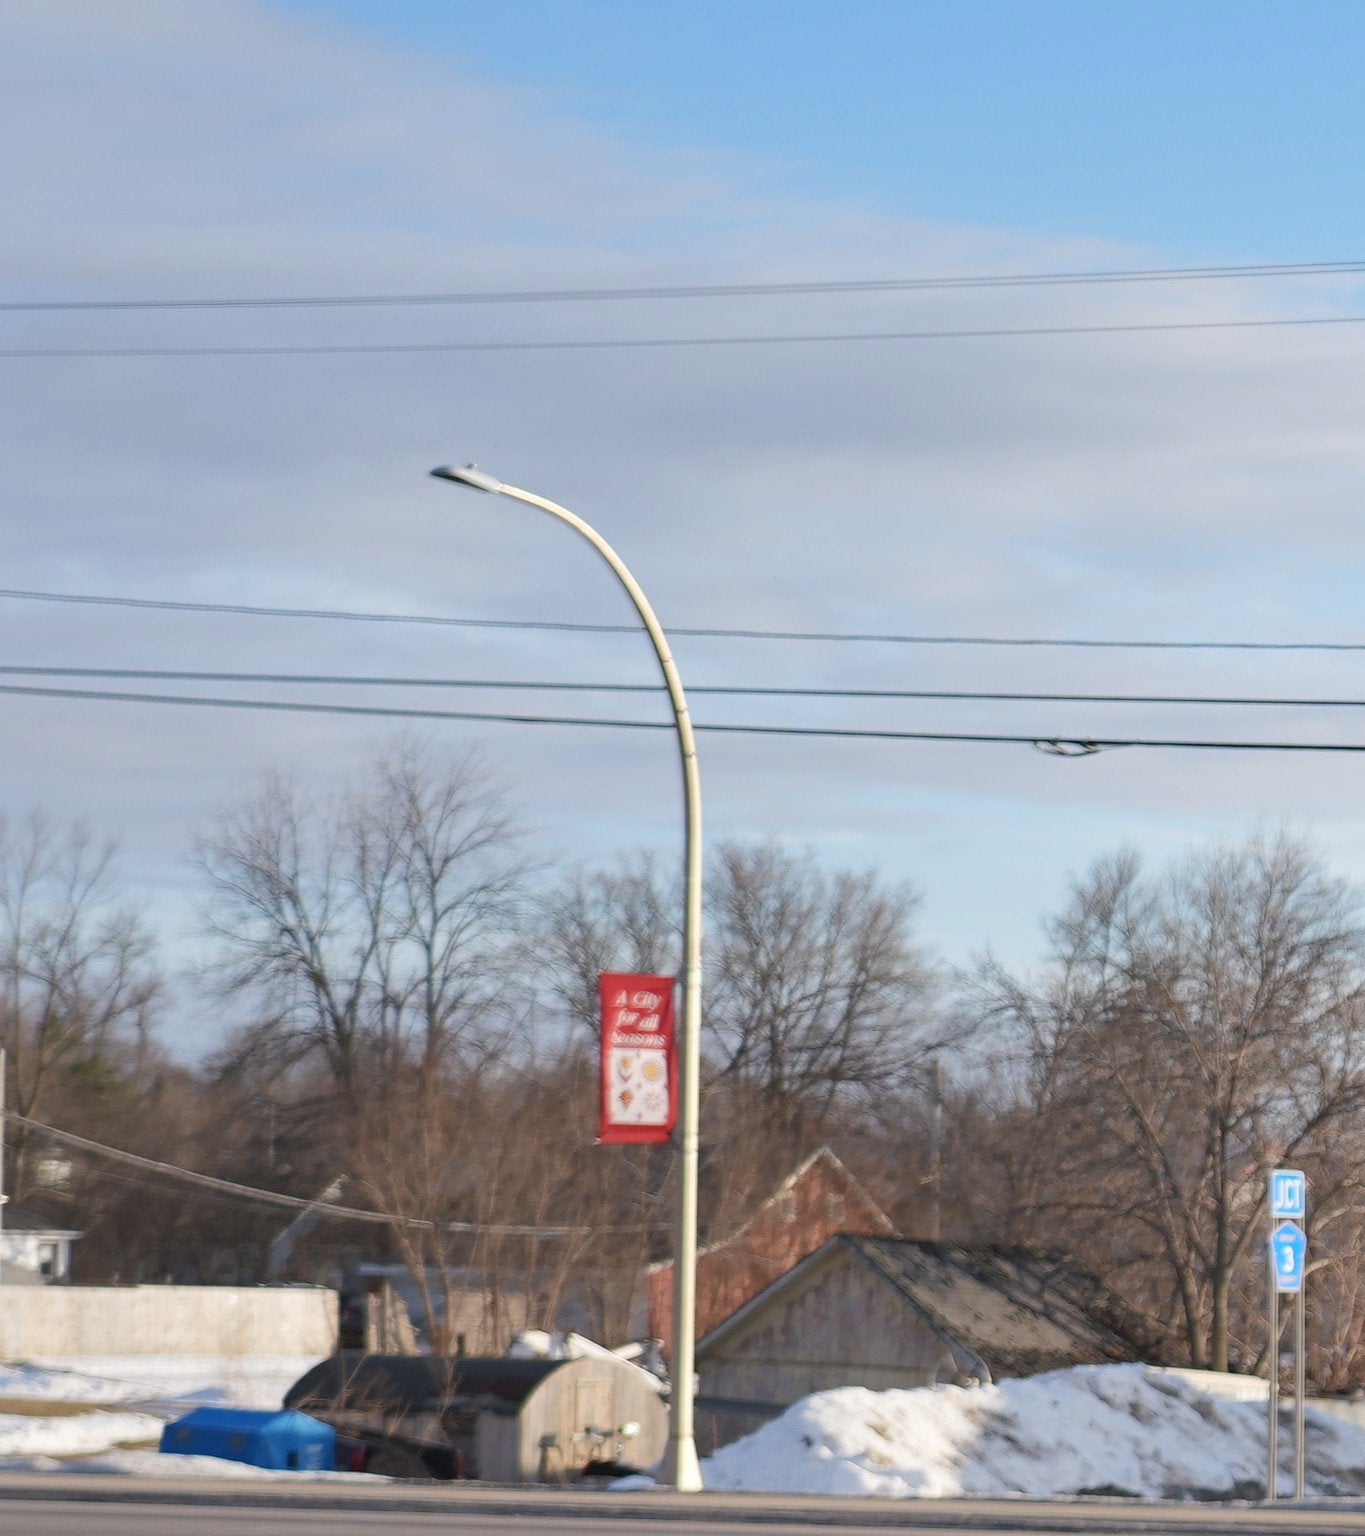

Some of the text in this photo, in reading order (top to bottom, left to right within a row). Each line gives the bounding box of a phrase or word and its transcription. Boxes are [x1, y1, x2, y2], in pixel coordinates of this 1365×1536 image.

[614, 990, 662, 1012] A City
[615, 1008, 660, 1031] for all
[1273, 1179, 1301, 1209] JCT
[1281, 1245, 1295, 1274] 3
